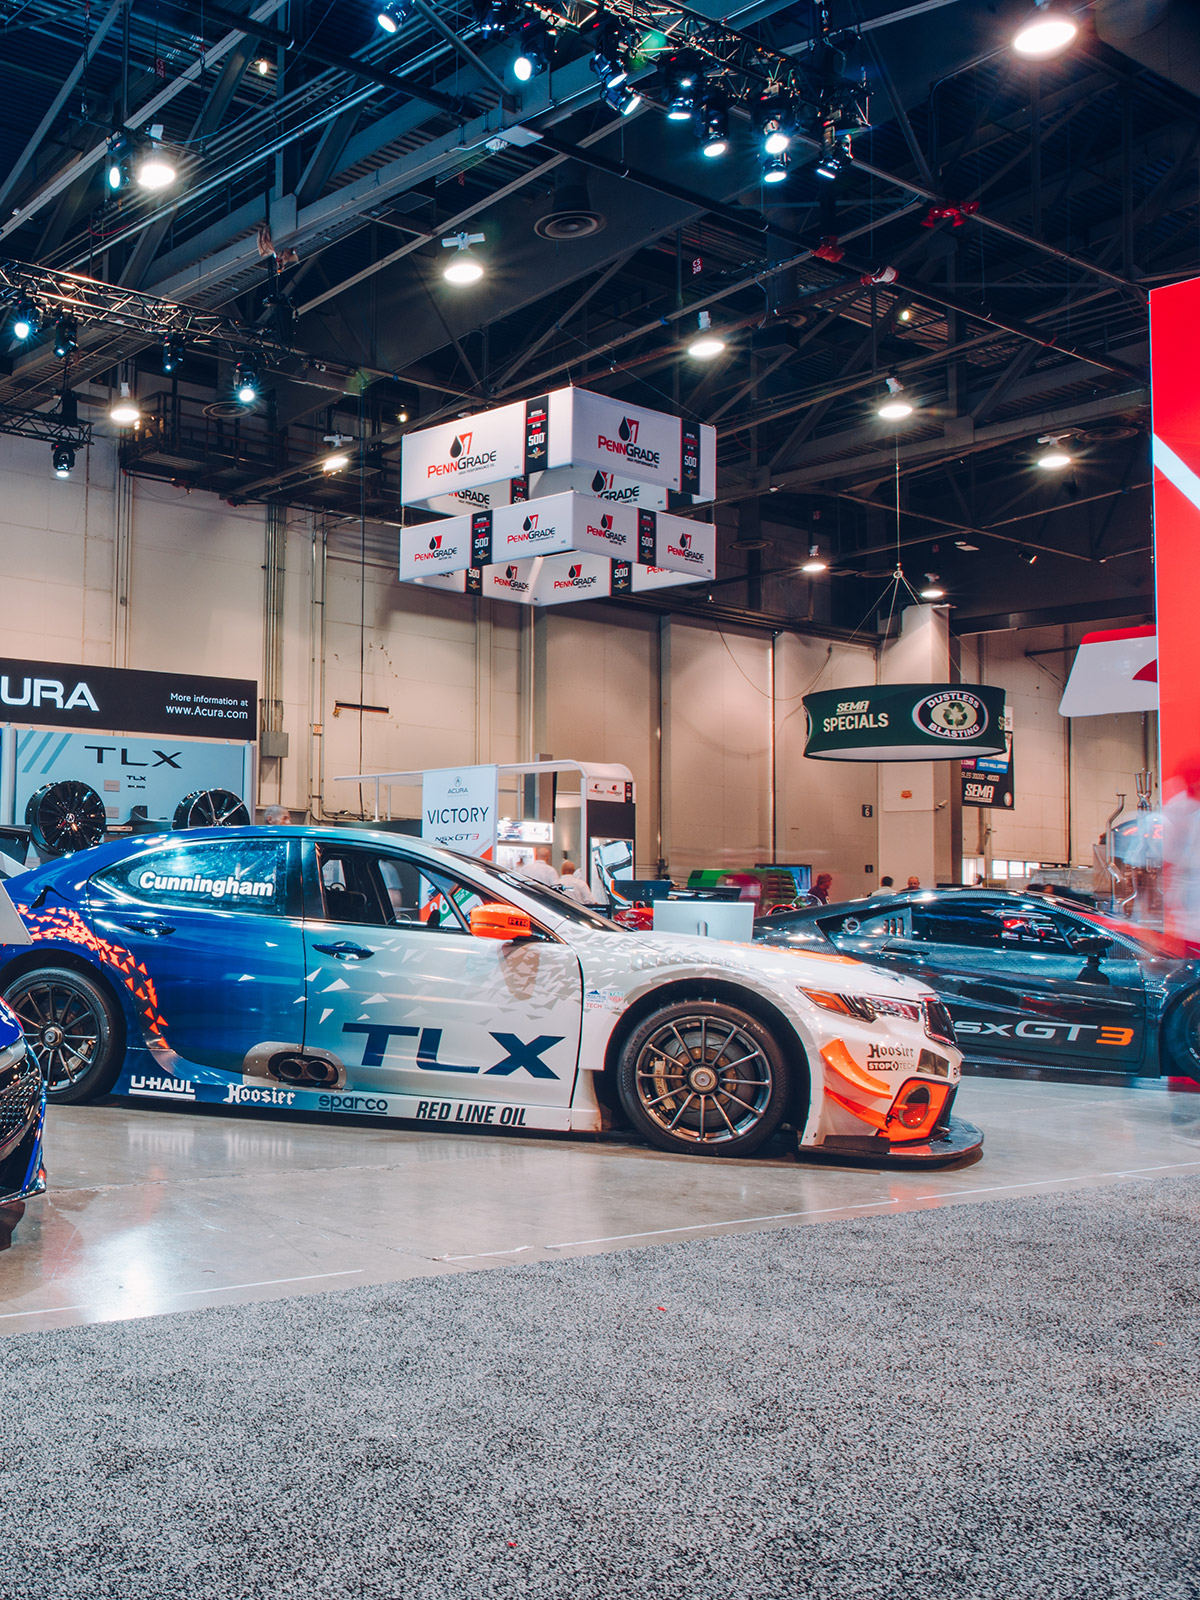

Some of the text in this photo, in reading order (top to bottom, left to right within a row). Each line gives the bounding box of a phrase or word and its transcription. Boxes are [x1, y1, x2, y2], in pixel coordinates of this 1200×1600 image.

[528, 433, 545, 447] 500
[684, 455, 697, 468] 500
[170, 692, 249, 707] More information at
[836, 700, 871, 713] SEMA
[927, 692, 980, 709] DUSTLESS
[166, 704, 248, 720] www.Acura.com
[823, 713, 889, 732] SPECIALS
[927, 723, 980, 738] BLASTING
[84, 745, 183, 769] TLX
[964, 783, 995, 799] SEMA
[427, 806, 489, 825] VICTORY
[138, 872, 274, 898] Cunningham
[954, 1020, 1135, 1046] SXGT3
[342, 1022, 566, 1080] TLX
[867, 1043, 914, 1058] Hoosier
[223, 1083, 296, 1106] Hoosier
[318, 1094, 389, 1113] sparco
[415, 1100, 527, 1127] RED LINE OIL
